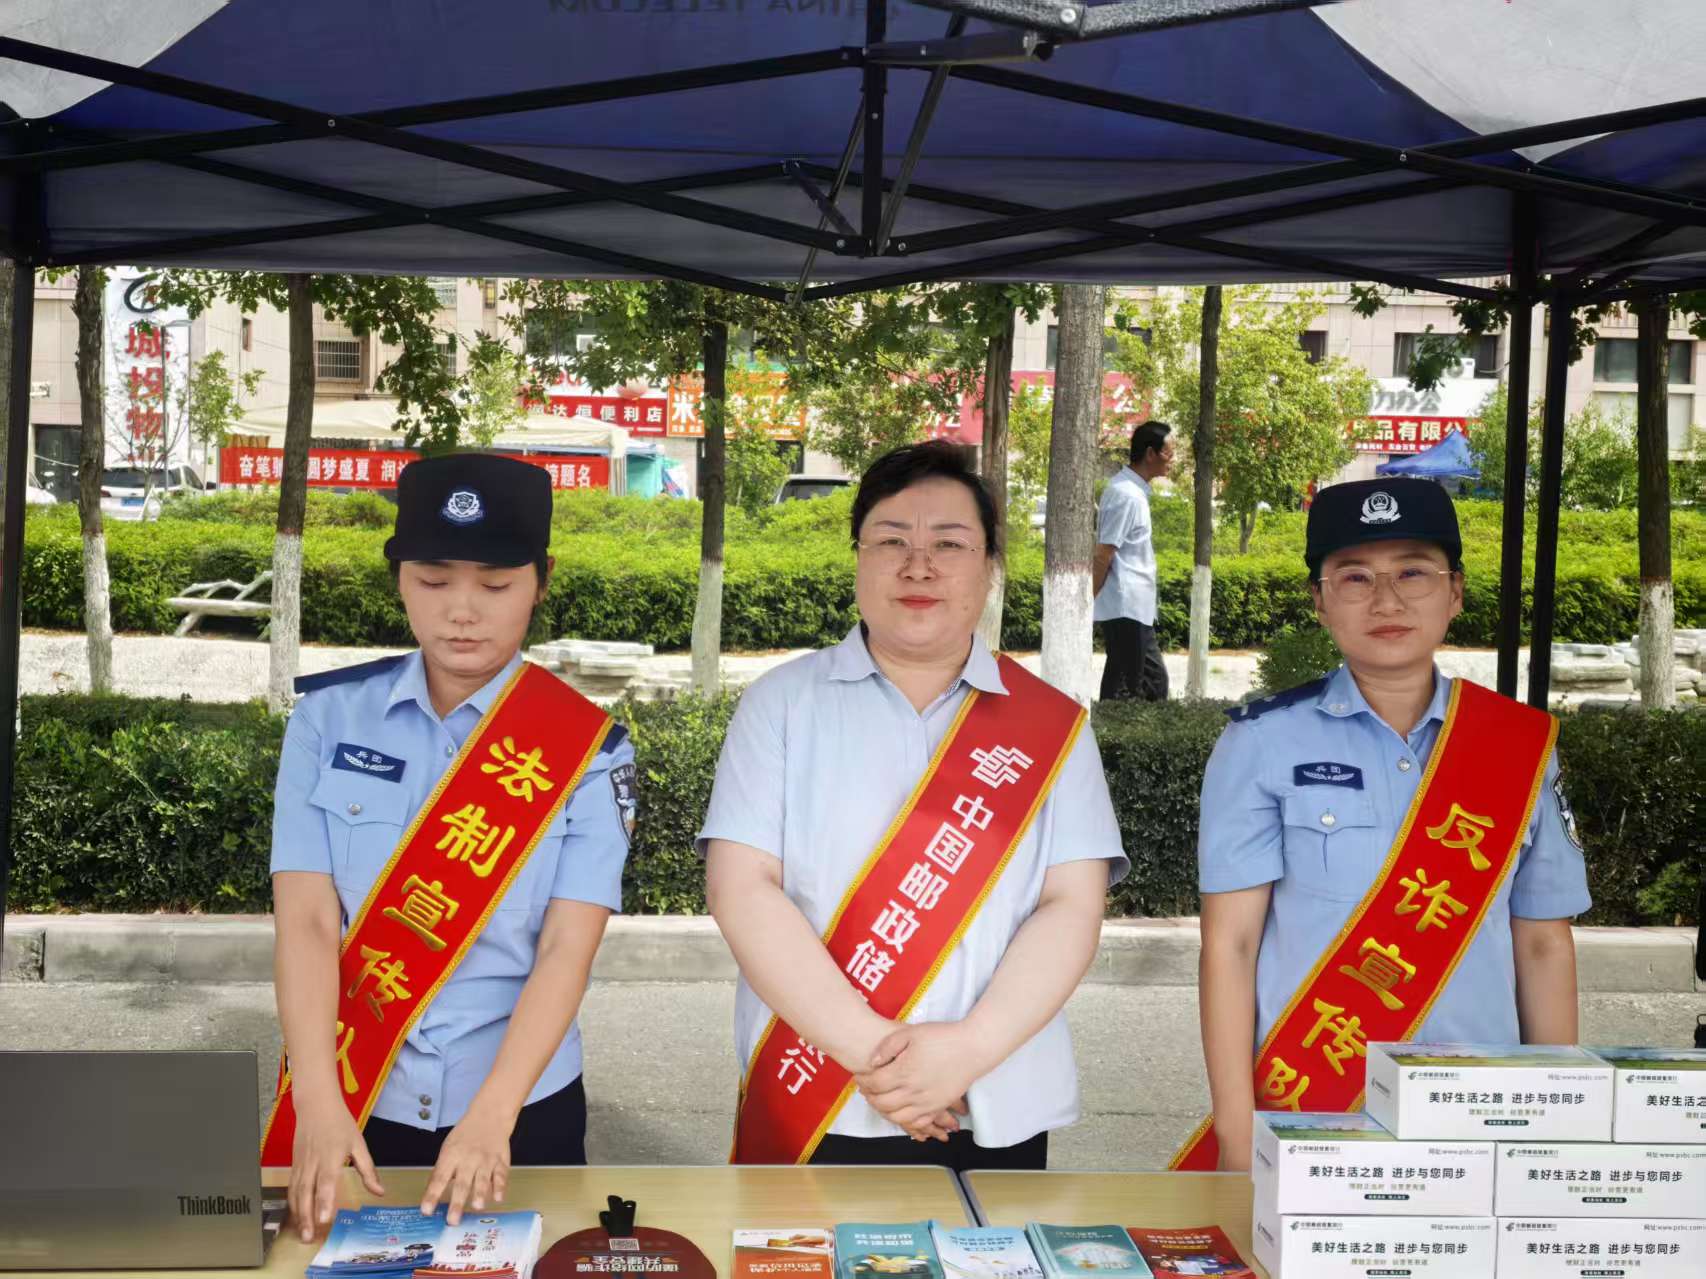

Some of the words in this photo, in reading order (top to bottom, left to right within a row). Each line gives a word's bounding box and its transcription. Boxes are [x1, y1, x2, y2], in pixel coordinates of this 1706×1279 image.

[1256, 802, 1496, 1112] 反诈宣传队
[1429, 1091, 1504, 1104] 美好生活之路
[1511, 1093, 1586, 1105] 进步与您同步
[1309, 1166, 1384, 1178] 美好生活之路
[1392, 1167, 1467, 1179] 进步与您同步
[1527, 1169, 1602, 1181] 美好生活之路
[1609, 1170, 1683, 1182] 进步与您同步
[177, 1195, 252, 1216] ThinkBook
[1311, 1242, 1386, 1254] 美好生活之路
[1394, 1242, 1469, 1255] 进步与您同步
[1526, 1243, 1600, 1255] 美好生活之路
[1607, 1243, 1681, 1255] 进步与您同步
